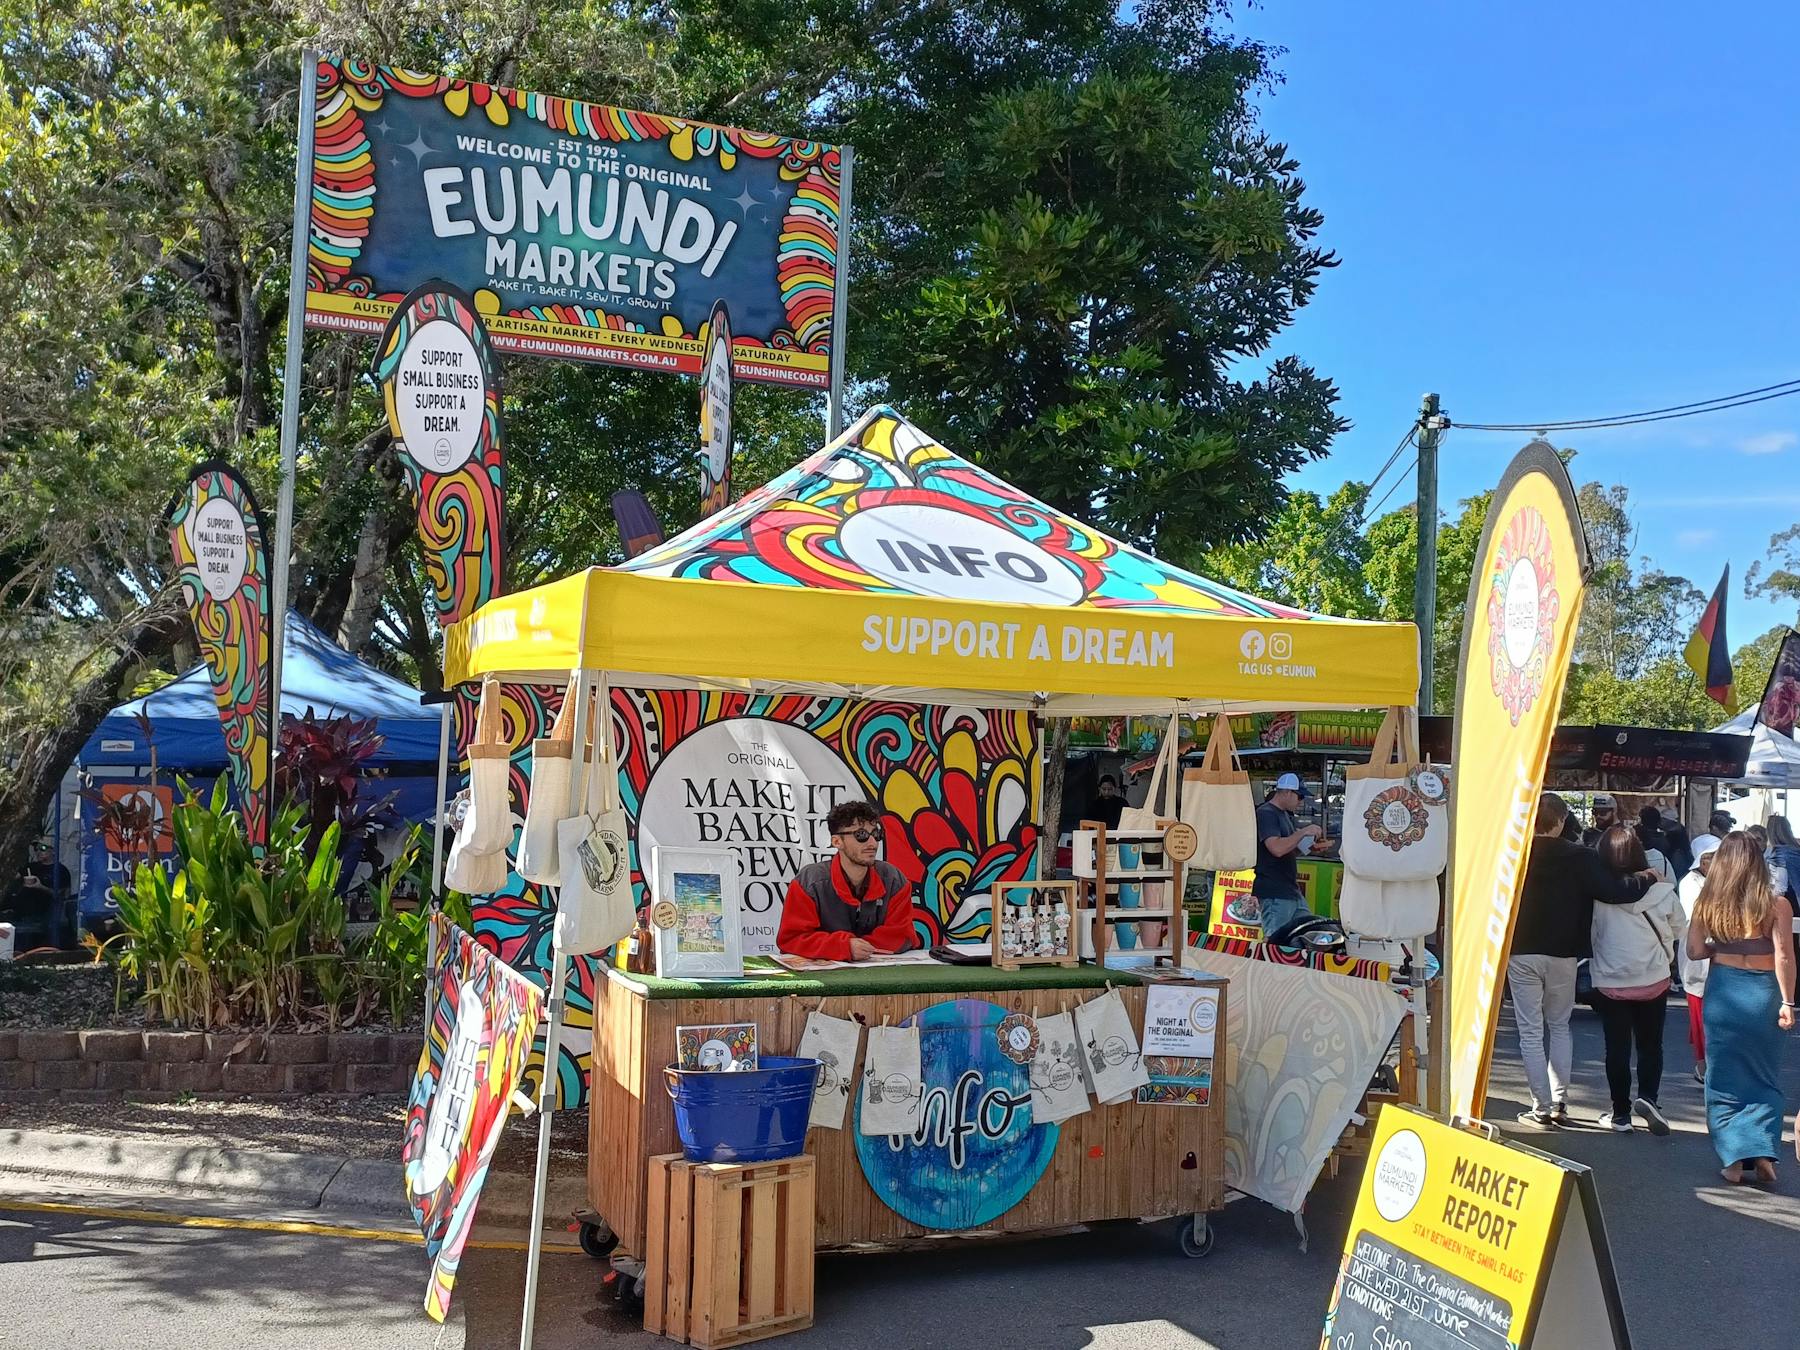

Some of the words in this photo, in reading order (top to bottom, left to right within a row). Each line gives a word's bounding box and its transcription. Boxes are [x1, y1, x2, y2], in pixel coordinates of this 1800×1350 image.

[558, 139, 582, 154] EST
[586, 143, 618, 158] 1979
[457, 135, 551, 164] WELCOME
[557, 153, 580, 169] TO
[586, 157, 620, 175] THE
[625, 163, 712, 191] ORIGINAL
[423, 166, 737, 278] EUMUNDI
[485, 236, 676, 299] MARKETS
[488, 278, 519, 291] MAKE
[522, 283, 535, 294] IT,
[539, 285, 566, 297] BAKE
[570, 288, 583, 300] IT,
[586, 291, 608, 303] SEW
[611, 294, 625, 306] IT,
[627, 296, 659, 310] GROW
[661, 301, 672, 311] IT
[495, 320, 549, 334] ARTISAN
[552, 327, 600, 340] MARKET
[611, 334, 646, 347] EVERY
[422, 350, 463, 367] SUPPORT
[734, 348, 791, 363] SATURDAY
[403, 371, 433, 387] SMALL
[437, 372, 479, 390] BUSINESS
[734, 365, 827, 384] TSUNSHINECOAST
[416, 393, 457, 410] SUPPORT
[460, 396, 466, 410] A
[207, 517, 233, 530] SUPPORT
[215, 533, 243, 545] BUSINESS
[203, 547, 229, 558] SUPPORT
[876, 538, 1048, 583] INFO
[862, 614, 1019, 659] SUPPORT
[1028, 625, 1051, 661] A
[1061, 626, 1174, 668] DREAM
[1238, 662, 1258, 675] TAG
[1260, 664, 1272, 676] US
[1196, 717, 1254, 736] BWL
[1303, 712, 1340, 721] HANDMADE
[1343, 715, 1361, 724] PORK
[1363, 716, 1376, 725] AND
[751, 742, 768, 751] THE
[727, 752, 795, 770] ORIGINAL
[1600, 752, 1650, 769] GERMAN
[1654, 755, 1709, 773] SAUSAGE
[1711, 759, 1738, 774] HUT
[681, 778, 796, 812] MAKE
[806, 784, 846, 814] IT
[694, 812, 801, 844] BAKE
[107, 853, 174, 874] ben
[758, 944, 775, 952] EST
[1148, 1027, 1160, 1035] THE
[1162, 1027, 1194, 1037] ORIGINAL
[1156, 1017, 1176, 1027] NIGHT
[1178, 1018, 1188, 1027] AT
[889, 1070, 1032, 1170] nfo
[1382, 1161, 1418, 1184] EUMUNDI
[1450, 1156, 1529, 1211] MARKET
[1378, 1172, 1415, 1196] MARKETS
[1442, 1194, 1517, 1251] REPORT
[1430, 1230, 1462, 1255] BETWEEN
[1462, 1245, 1477, 1261] THE
[1477, 1252, 1498, 1272] SWIRL
[1356, 1240, 1392, 1272] WELCOME
[1394, 1258, 1408, 1280] TO:
[1412, 1264, 1427, 1289] The
[1426, 1274, 1460, 1305] Original
[1346, 1281, 1395, 1321] CONDITIONS:
[1352, 1260, 1375, 1285] DATE:
[1375, 1272, 1400, 1300] WED
[1400, 1288, 1429, 1317] 21ST
[1434, 1303, 1469, 1337] June
